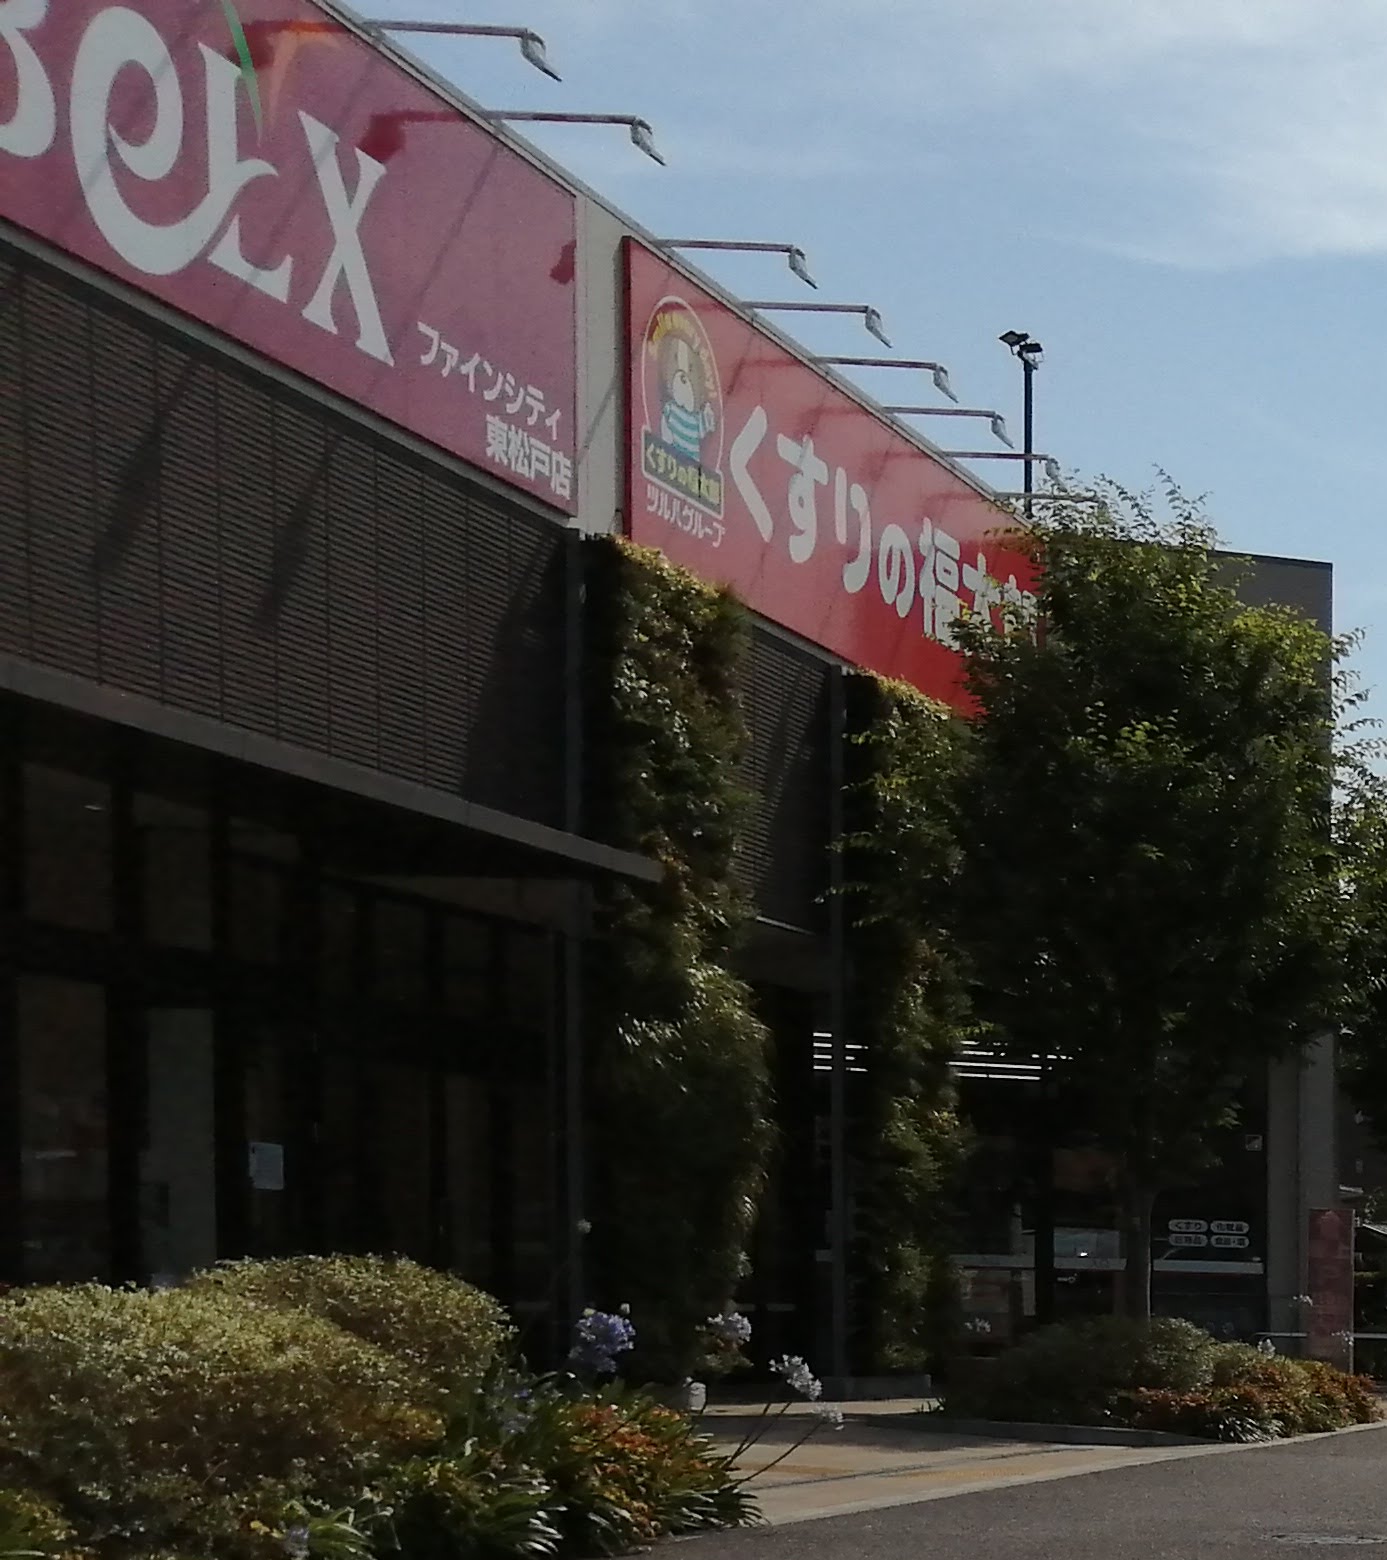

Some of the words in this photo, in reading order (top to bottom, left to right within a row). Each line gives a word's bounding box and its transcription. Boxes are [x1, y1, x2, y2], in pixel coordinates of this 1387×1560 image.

[417, 321, 562, 441] ファインシティ
[485, 413, 573, 500] 東松戸店
[646, 483, 726, 548] ツルハグループ
